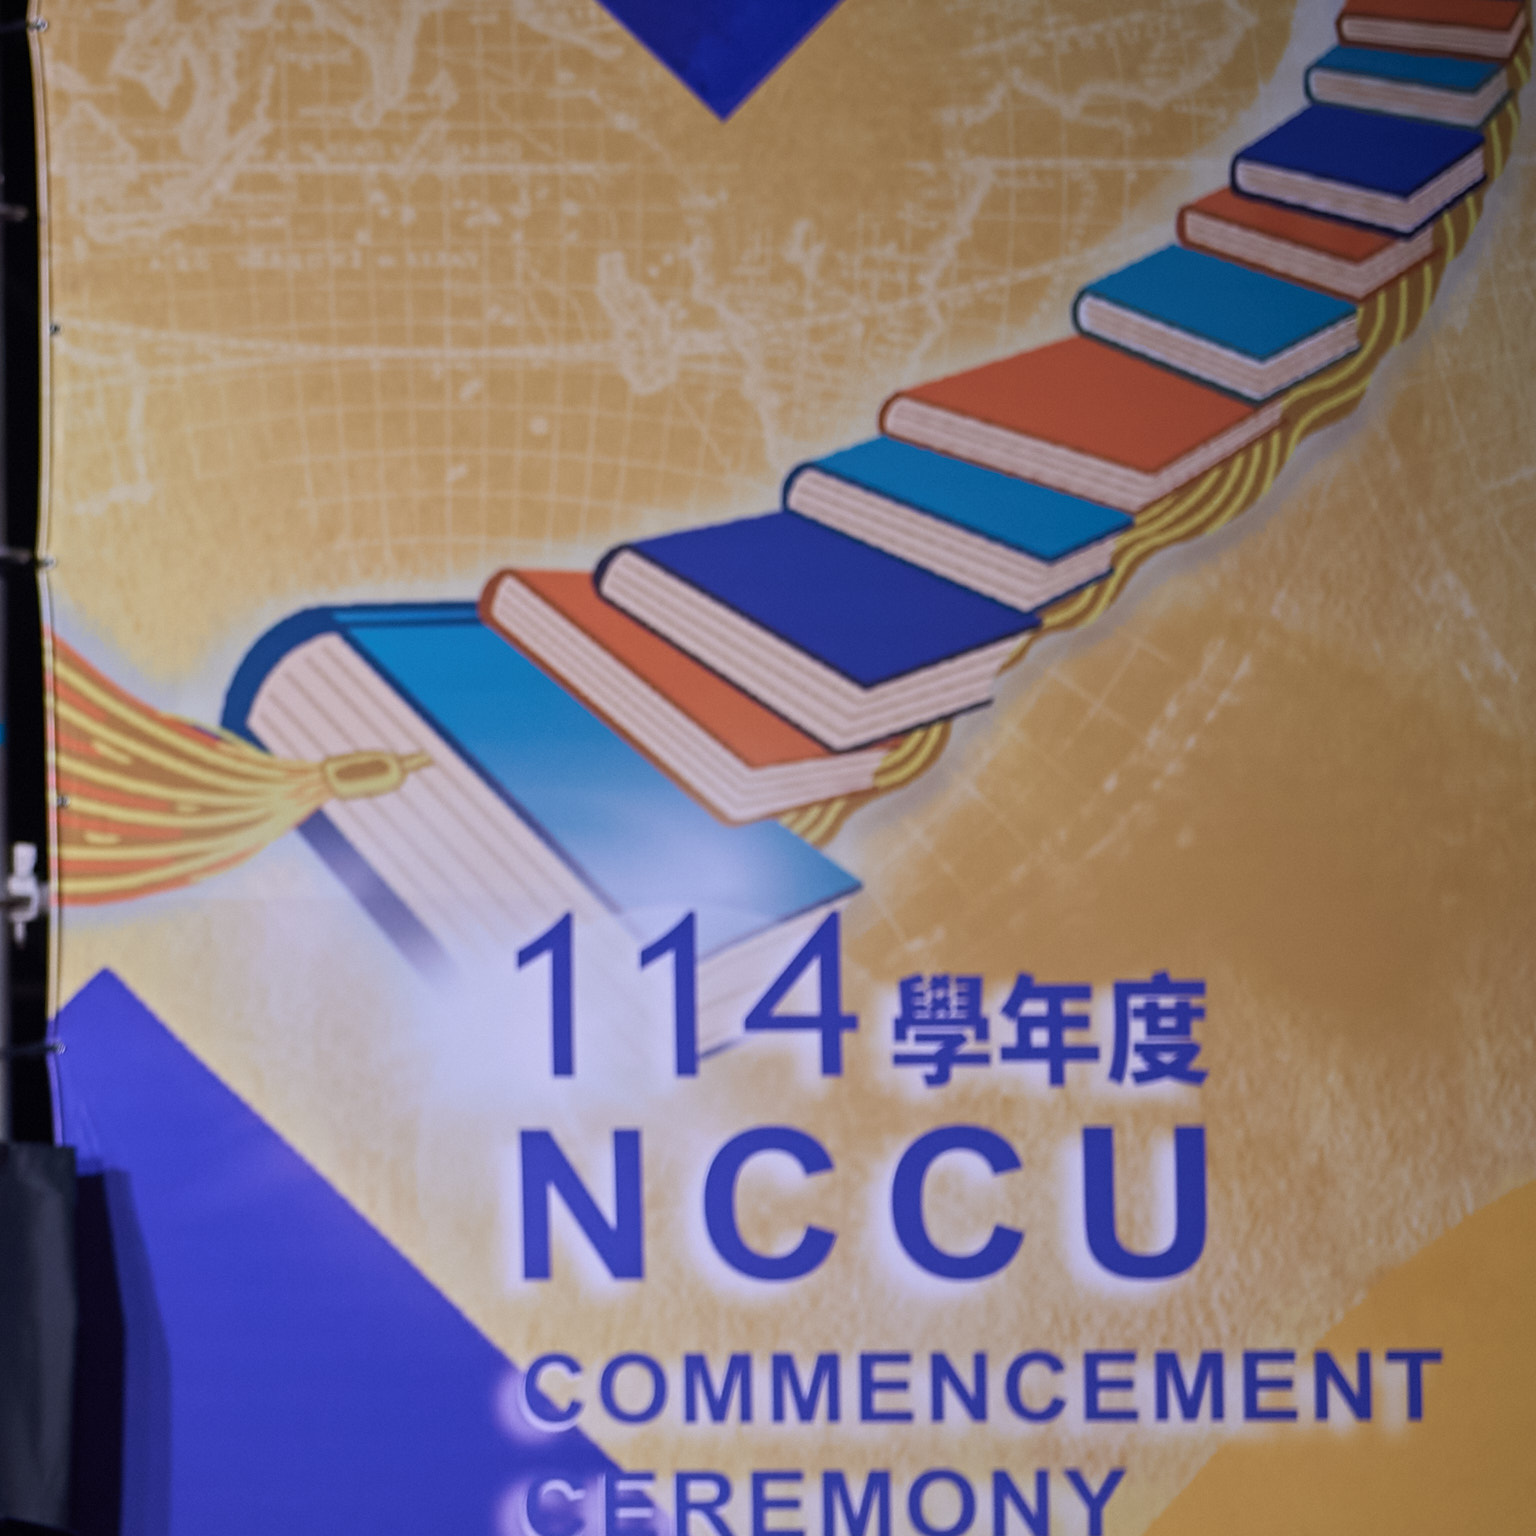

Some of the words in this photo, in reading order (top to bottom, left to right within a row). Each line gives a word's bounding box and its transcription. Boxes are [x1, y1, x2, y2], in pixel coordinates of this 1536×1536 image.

[516, 911, 859, 1078] 114
[890, 970, 1210, 1088] 學年度
[520, 1125, 1209, 1281] NCCU
[521, 1349, 1443, 1433] COMMENCEMENT
